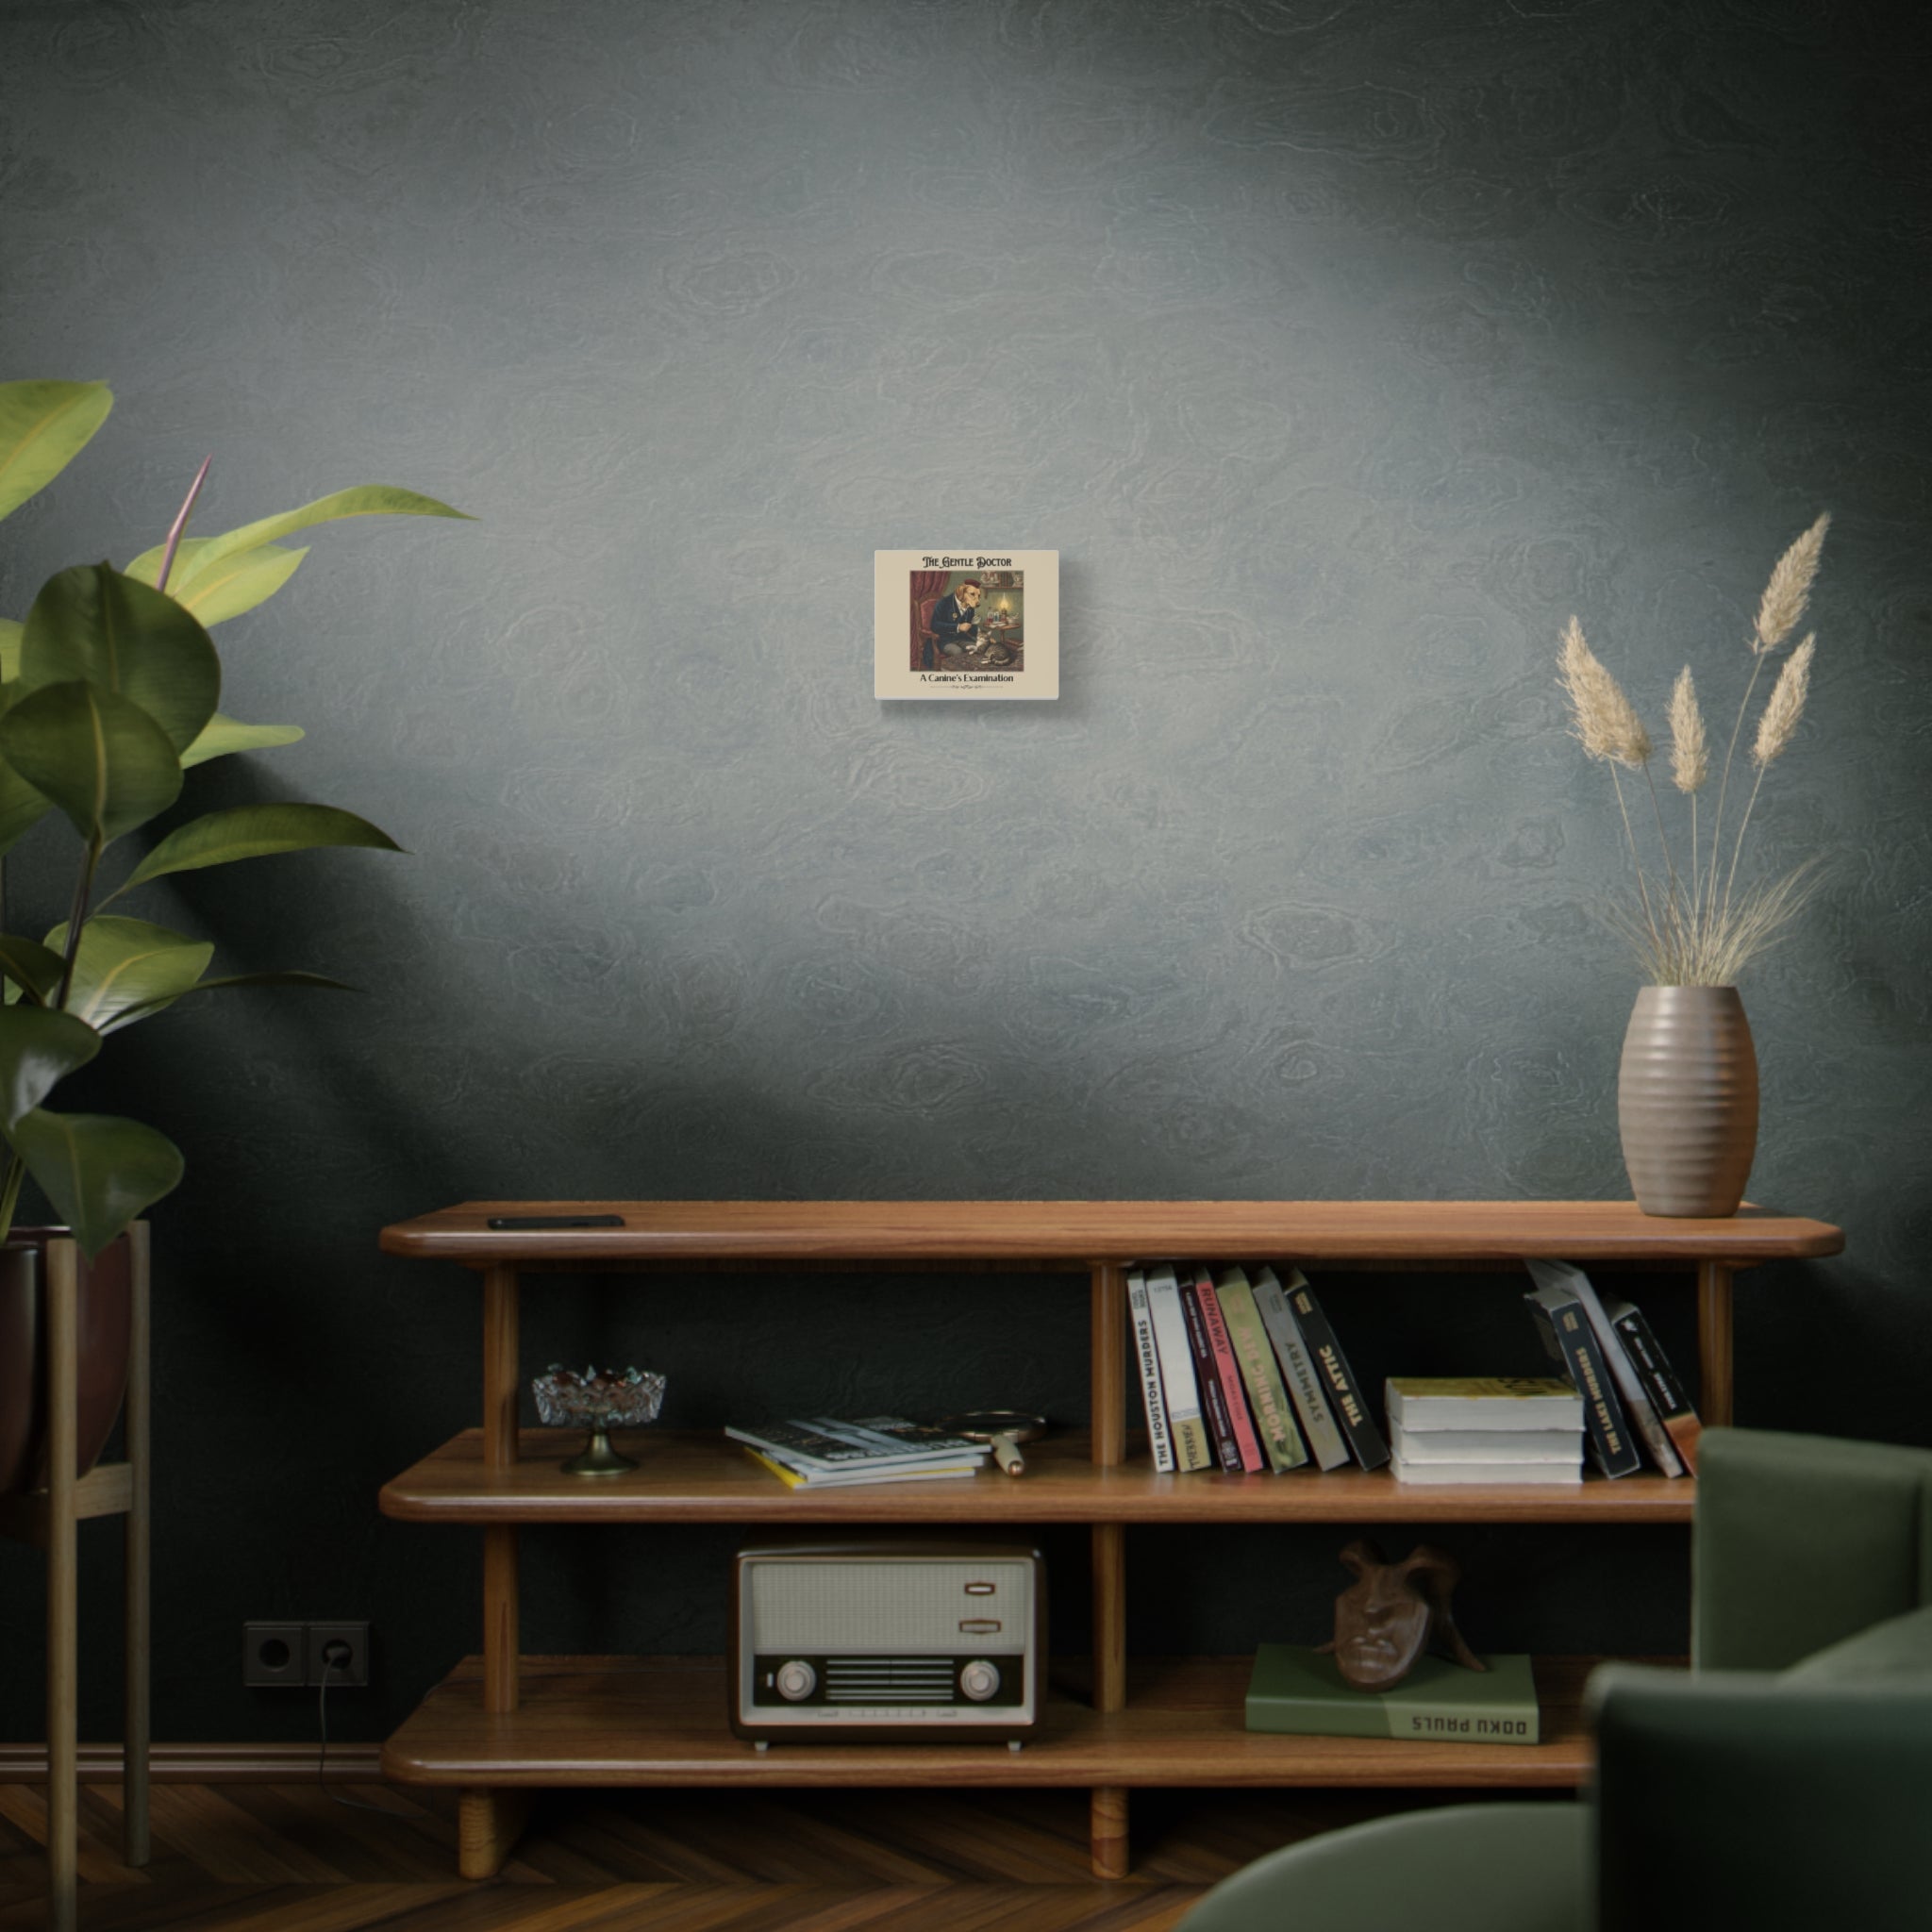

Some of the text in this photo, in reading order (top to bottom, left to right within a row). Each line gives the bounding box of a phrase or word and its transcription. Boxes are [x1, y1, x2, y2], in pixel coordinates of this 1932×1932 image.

[922, 557, 1011, 569] THE GENTLE DOCTOR
[928, 674, 962, 682] Canine's
[963, 674, 1013, 682] Examination
[1138, 1319, 1157, 1378] MURDERS
[1201, 1287, 1229, 1355] RUNAWAY
[1239, 1326, 1286, 1442] MORNING DEW
[1287, 1341, 1324, 1424] SYMMETRY
[1319, 1343, 1364, 1427] THE ATTIC
[1575, 1346, 1603, 1399] MURDERS
[1148, 1380, 1165, 1441] HOUSTON
[1158, 1442, 1169, 1466] THE
[1604, 1429, 1622, 1456] THE
[1412, 1716, 1470, 1733] PAULS
